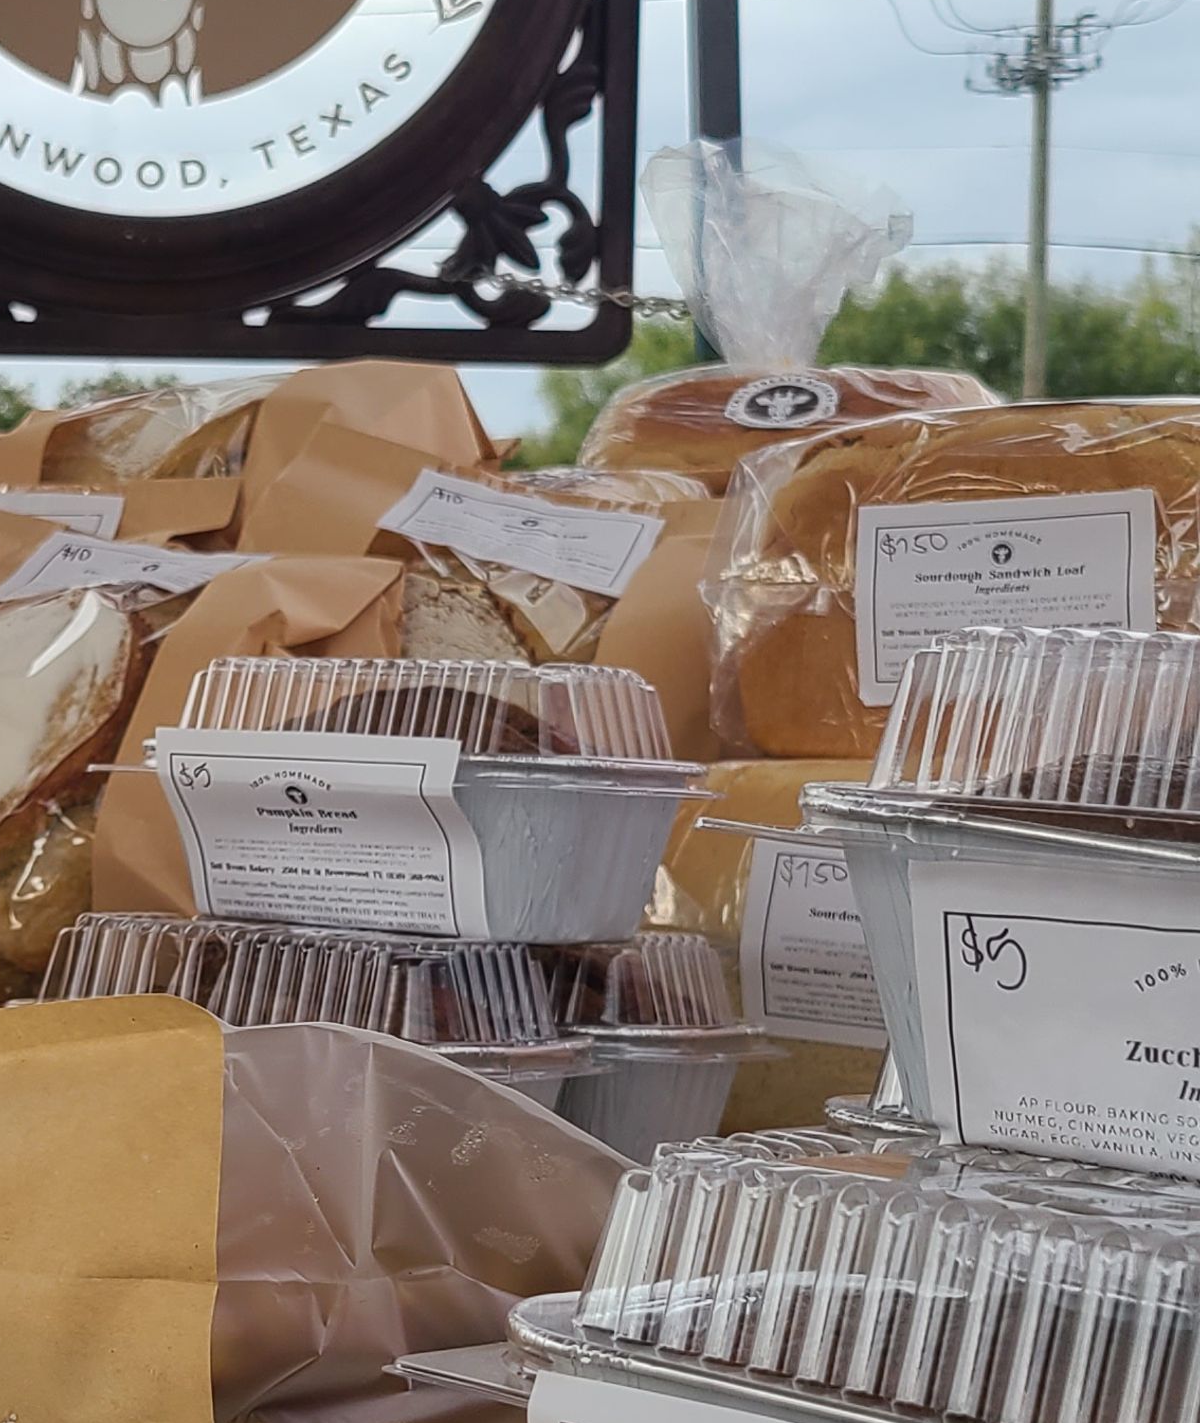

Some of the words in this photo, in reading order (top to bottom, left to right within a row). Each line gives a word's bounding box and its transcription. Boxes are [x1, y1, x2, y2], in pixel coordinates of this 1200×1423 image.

[251, 51, 413, 171] TEXAS
[914, 570, 982, 584] Sourdough
[989, 566, 1051, 580] Sandwich
[1057, 564, 1085, 576] Loaf
[962, 915, 1026, 990] $5
[1134, 962, 1188, 992] 100%
[994, 1109, 1062, 1131] NUTMEG,
[1019, 1096, 1038, 1108] AP
[1107, 1107, 1169, 1125] BAKING
[990, 1124, 1045, 1143] SUGAR,
